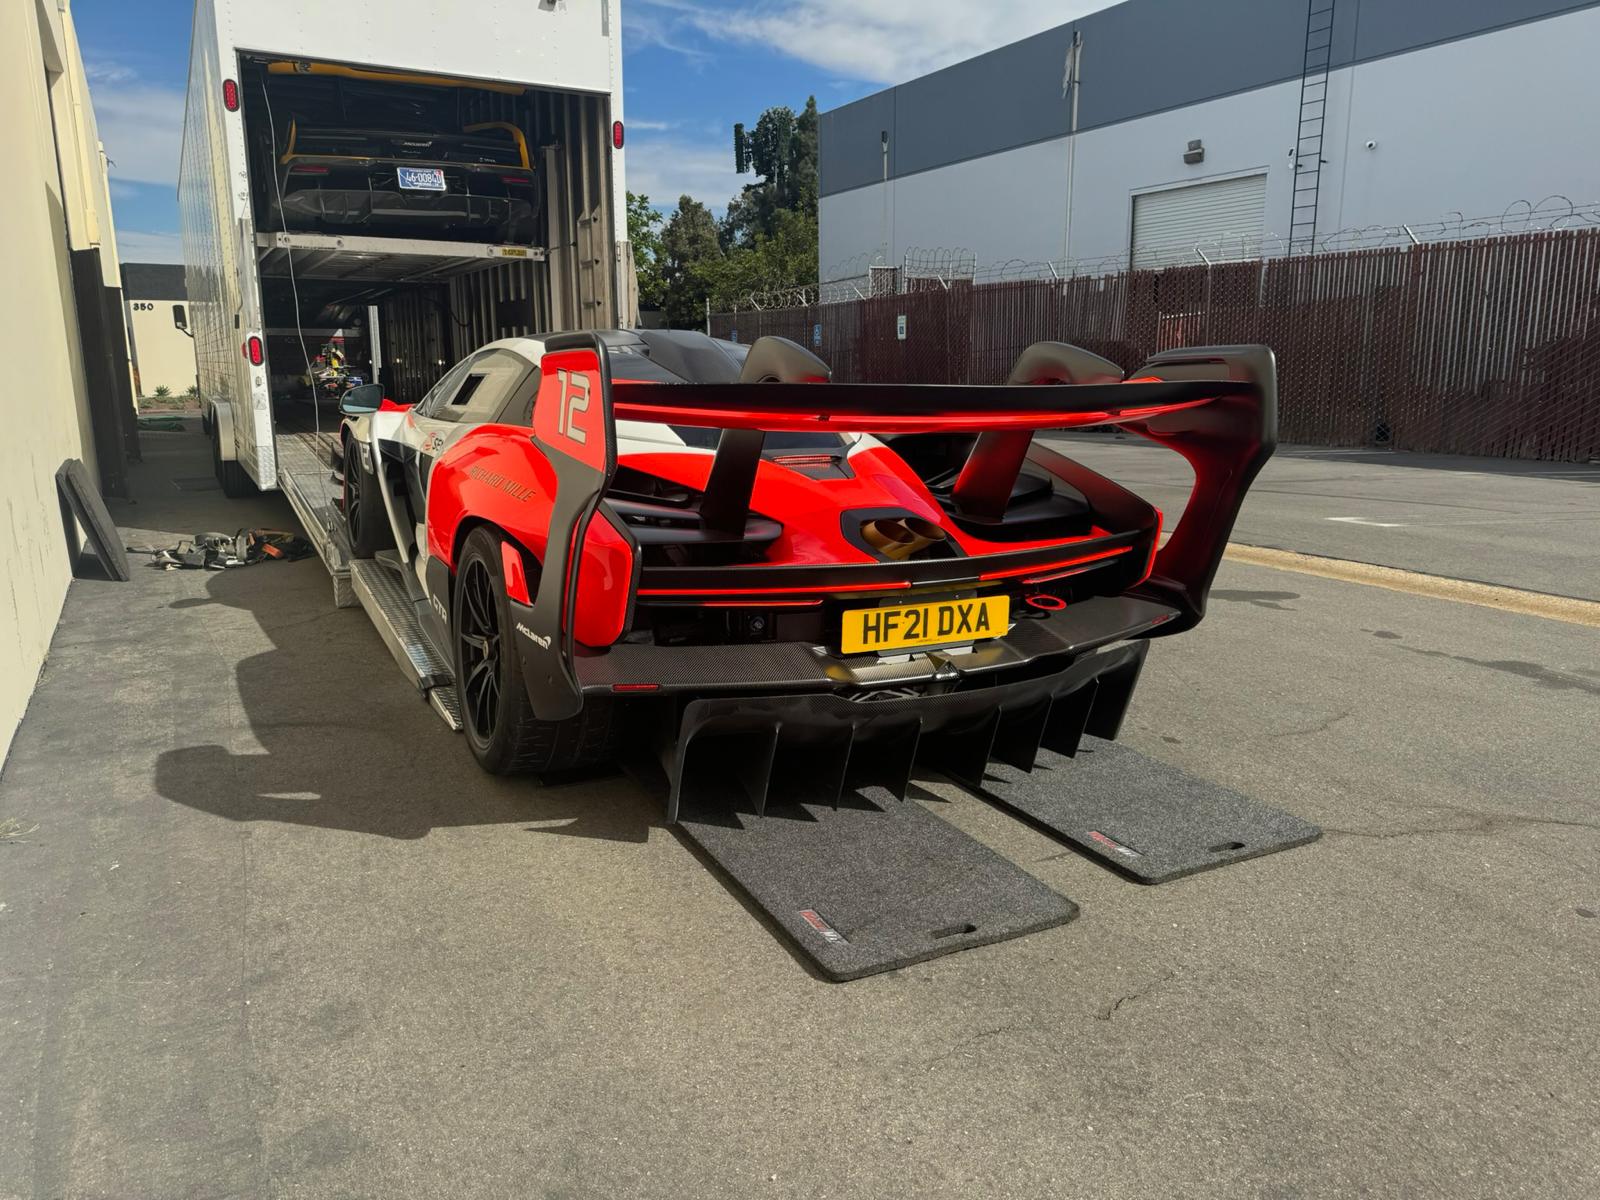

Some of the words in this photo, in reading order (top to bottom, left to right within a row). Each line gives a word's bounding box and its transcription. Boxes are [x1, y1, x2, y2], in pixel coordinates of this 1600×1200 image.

[133, 302, 154, 311] 350
[556, 368, 591, 446] 12
[503, 481, 536, 502] MILLE
[433, 593, 448, 625] GTR
[863, 607, 929, 645] HF21
[937, 602, 990, 637] DXA
[516, 622, 550, 650] McLaren
